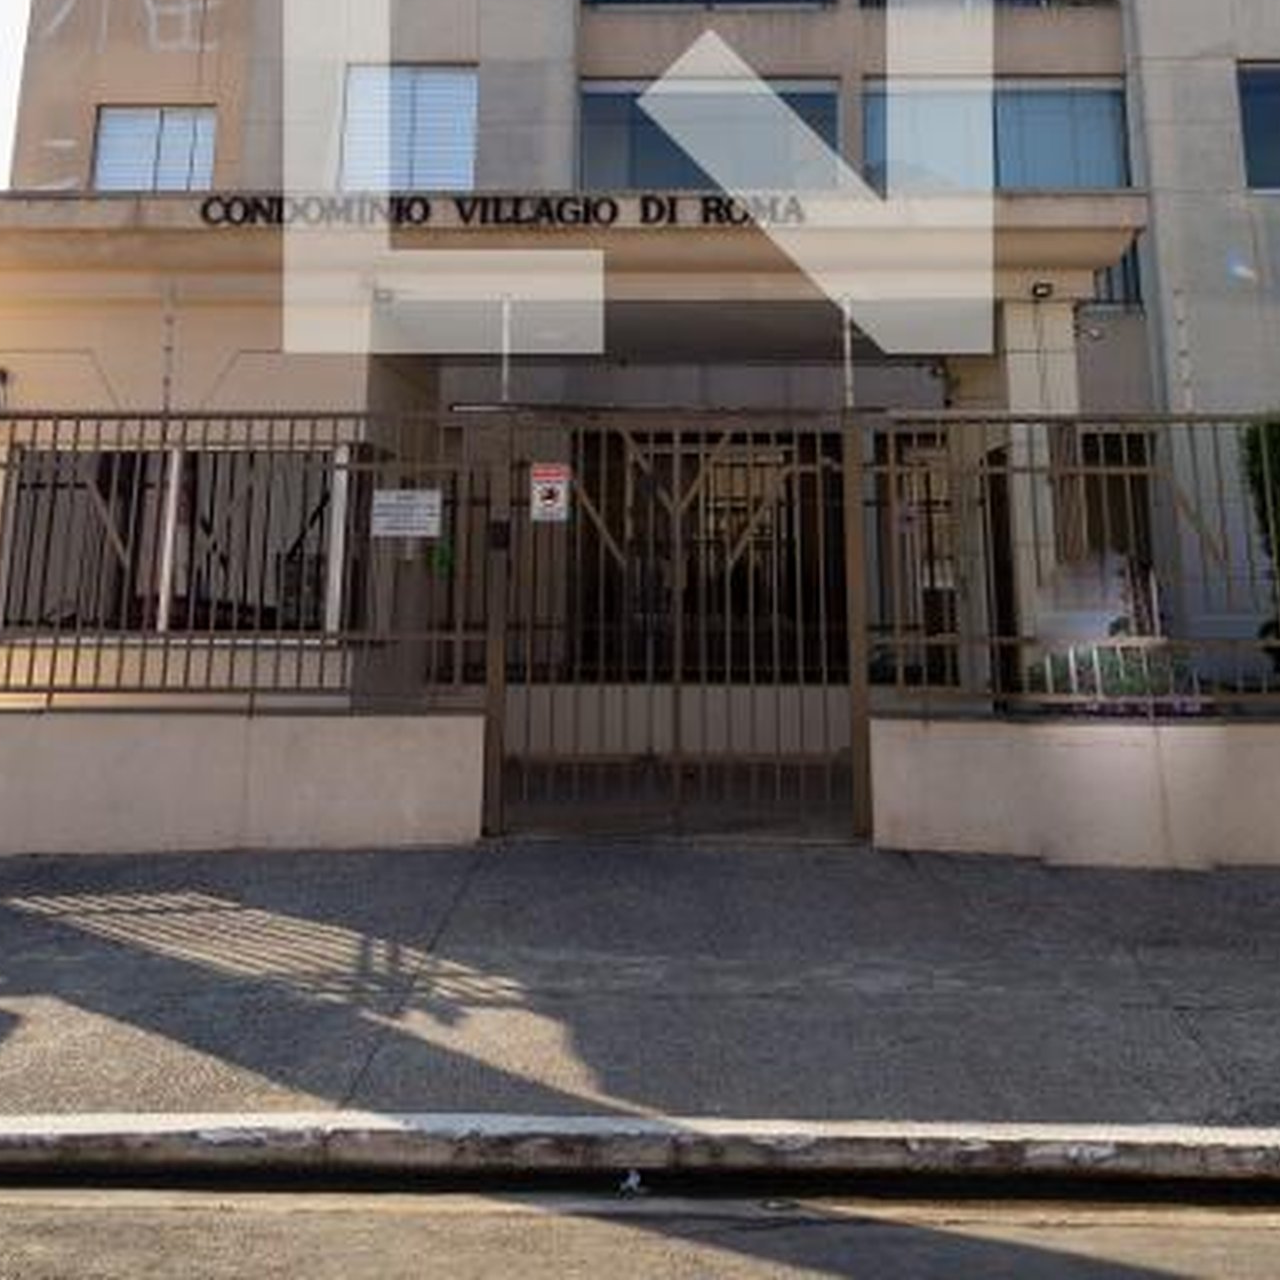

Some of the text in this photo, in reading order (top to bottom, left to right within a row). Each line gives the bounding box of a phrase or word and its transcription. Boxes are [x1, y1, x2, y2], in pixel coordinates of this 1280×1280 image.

[454, 195, 619, 226] VILLAGIO
[639, 194, 677, 225] DI
[701, 194, 807, 226] ROMA
